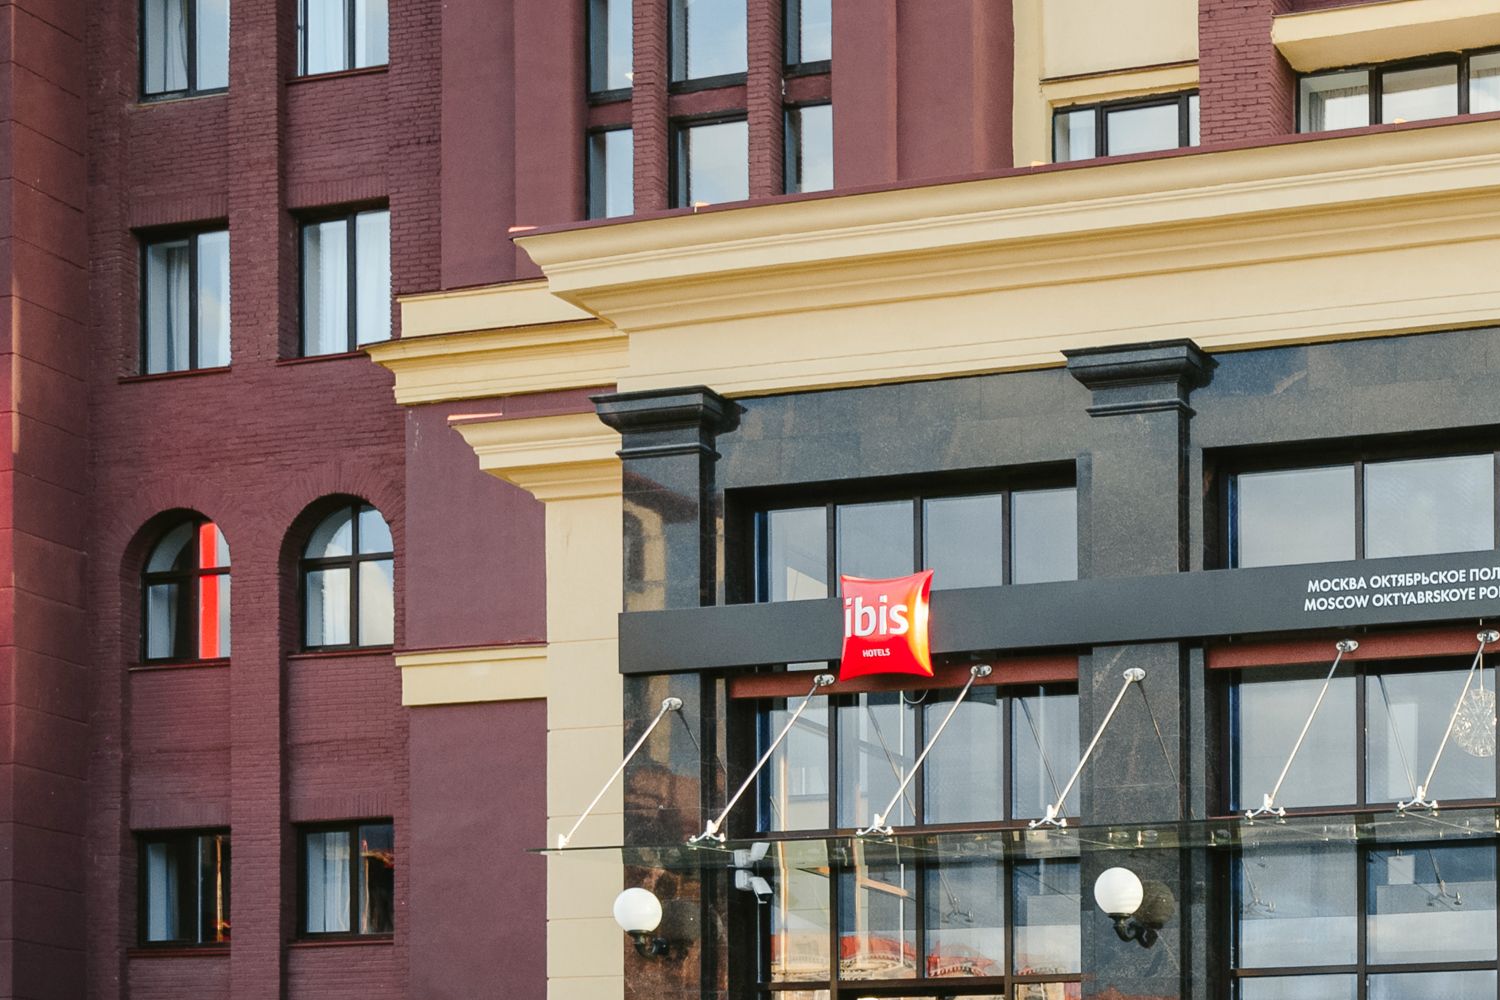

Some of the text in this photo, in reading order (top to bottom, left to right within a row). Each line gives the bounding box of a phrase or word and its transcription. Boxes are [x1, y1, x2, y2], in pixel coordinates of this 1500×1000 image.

[1307, 577, 1367, 593] МОСКВА
[1369, 569, 1466, 589] ОКТЯБРЬСКОЕ
[1304, 594, 1370, 612] MOSCOW
[1372, 587, 1476, 607] OKTYABRSKOYE
[844, 594, 910, 638] ibis
[862, 648, 891, 658] HOTELS
